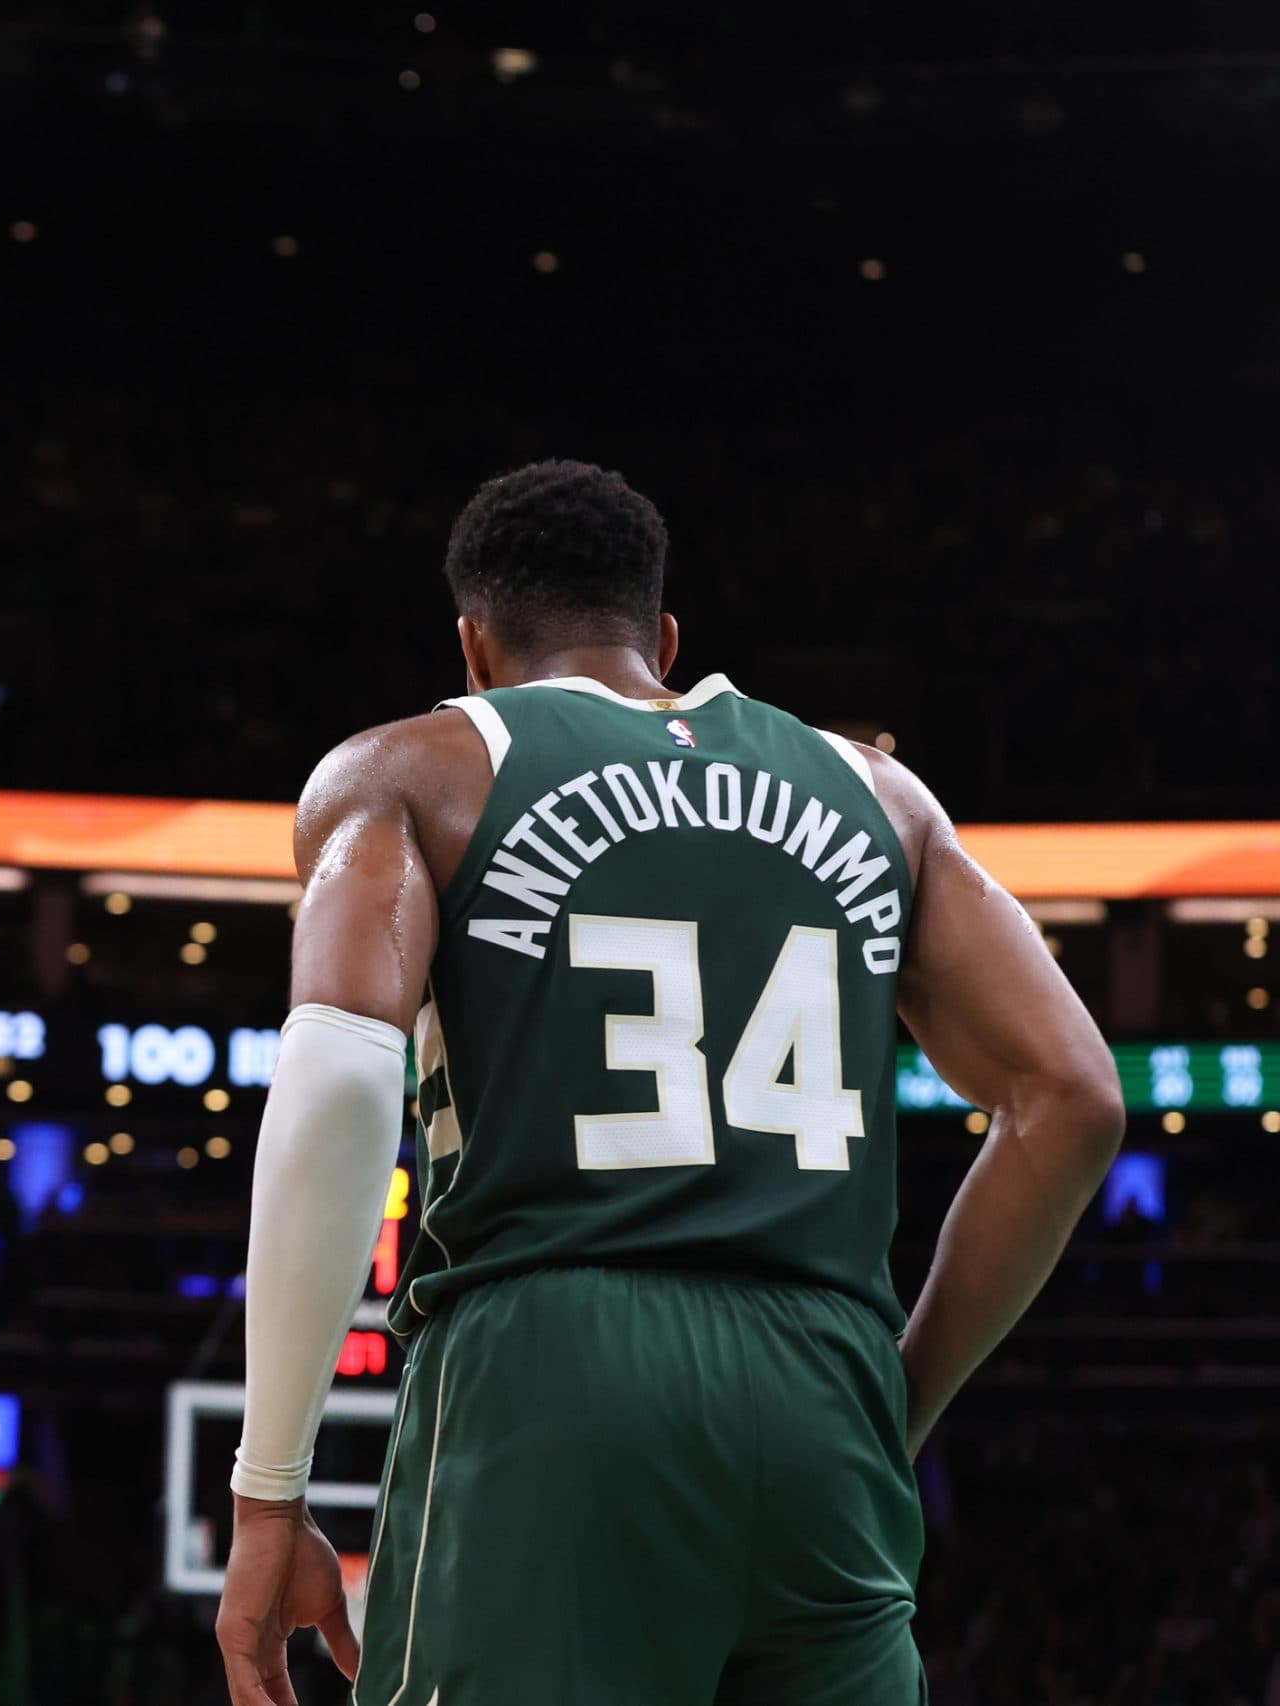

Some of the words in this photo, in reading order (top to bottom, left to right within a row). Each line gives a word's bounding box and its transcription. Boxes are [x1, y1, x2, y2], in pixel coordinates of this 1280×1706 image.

[467, 759, 902, 975] ANTETOKOUNMPO
[97, 1023, 215, 1087] 100
[569, 913, 866, 1171] 34
